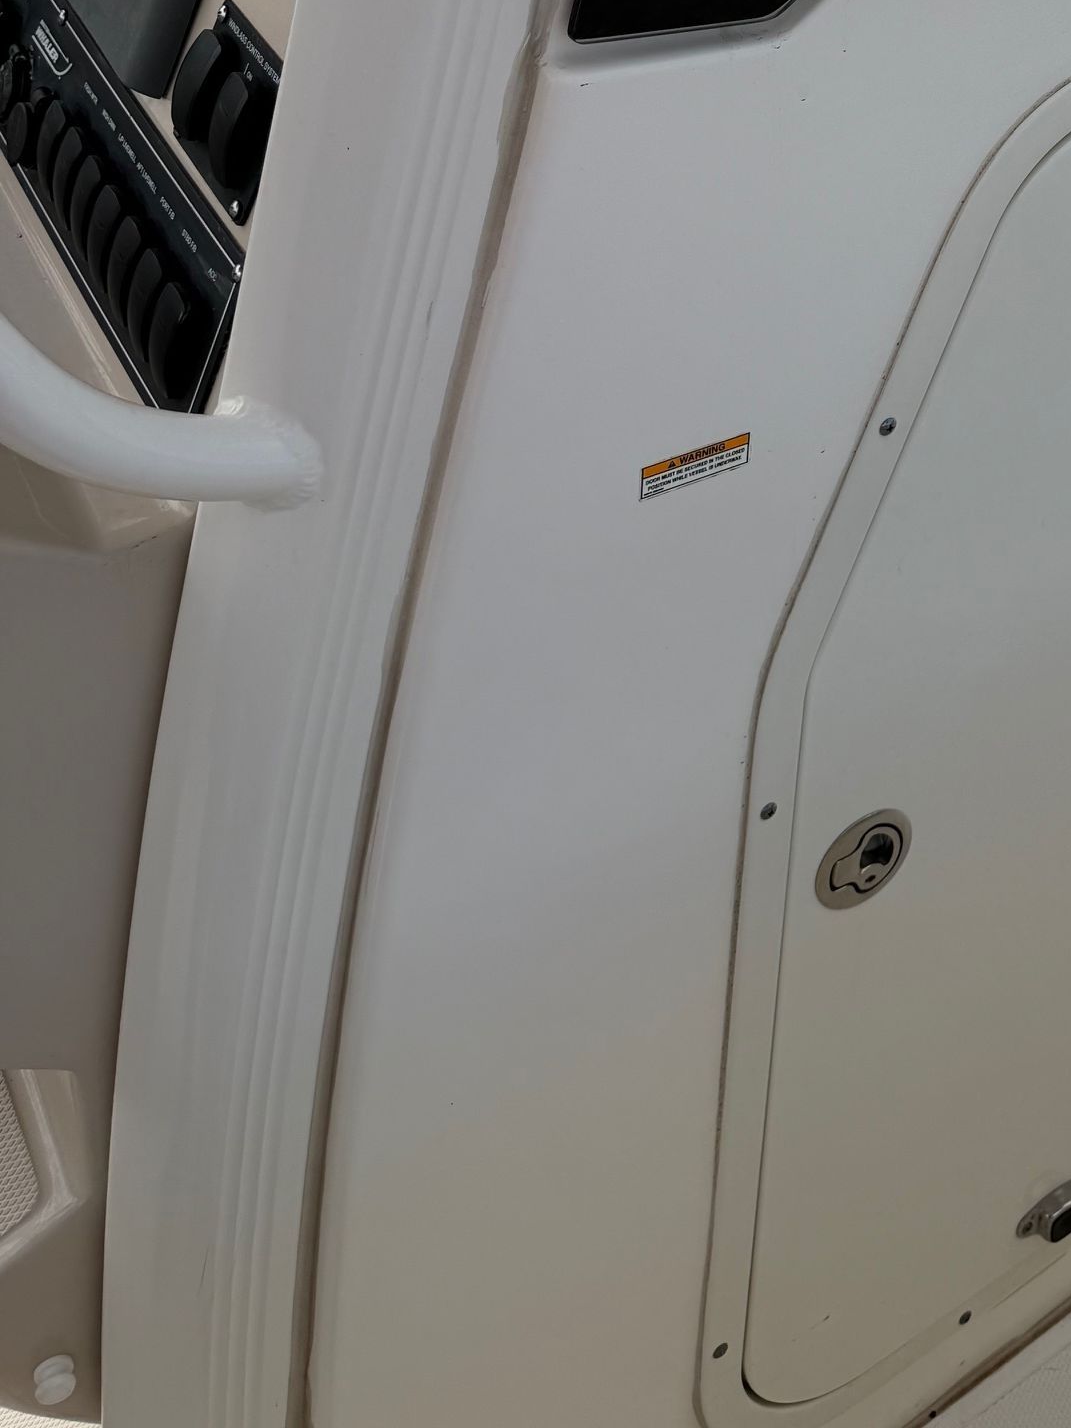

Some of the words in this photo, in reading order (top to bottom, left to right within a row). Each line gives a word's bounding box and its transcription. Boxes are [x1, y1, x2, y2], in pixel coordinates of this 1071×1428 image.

[35, 25, 59, 63] WHALER
[228, 17, 248, 45] WINDLASS
[246, 40, 264, 67] CONTROL
[645, 476, 661, 486] DOOR
[661, 471, 676, 480] MUST
[684, 460, 708, 473] SECURED
[714, 454, 724, 463] THE
[725, 447, 745, 458] CLOSED
[679, 443, 726, 465] WARNING
[647, 479, 672, 492] POSITION
[672, 473, 688, 483] WHILE
[688, 467, 708, 478] VESSEL
